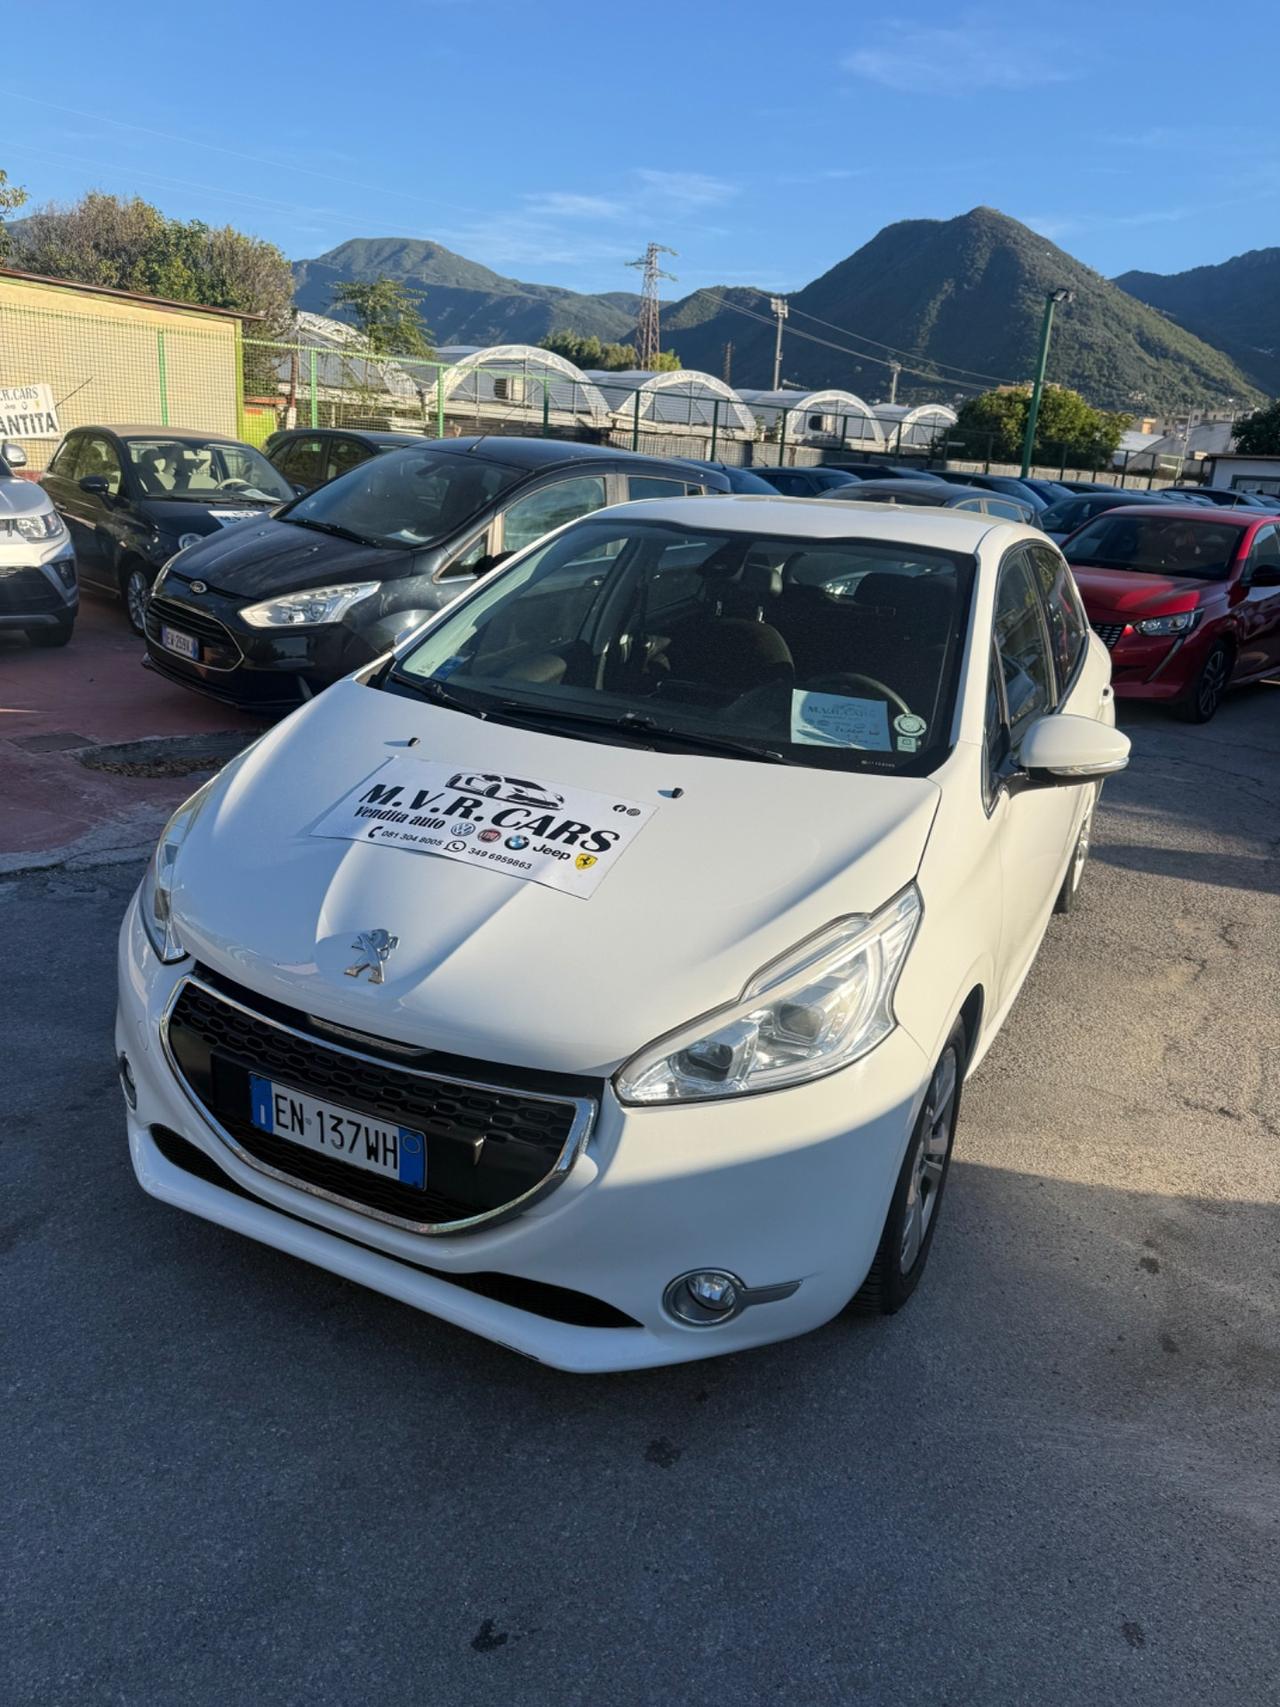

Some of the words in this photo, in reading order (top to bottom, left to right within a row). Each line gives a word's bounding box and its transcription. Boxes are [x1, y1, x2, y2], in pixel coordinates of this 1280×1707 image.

[354, 806, 409, 823] Vendita
[409, 815, 446, 830] auto
[358, 784, 620, 852] M.V.R.CARS
[468, 847, 488, 857] 349
[488, 853, 532, 870] 6959863
[532, 844, 571, 860] Jeep
